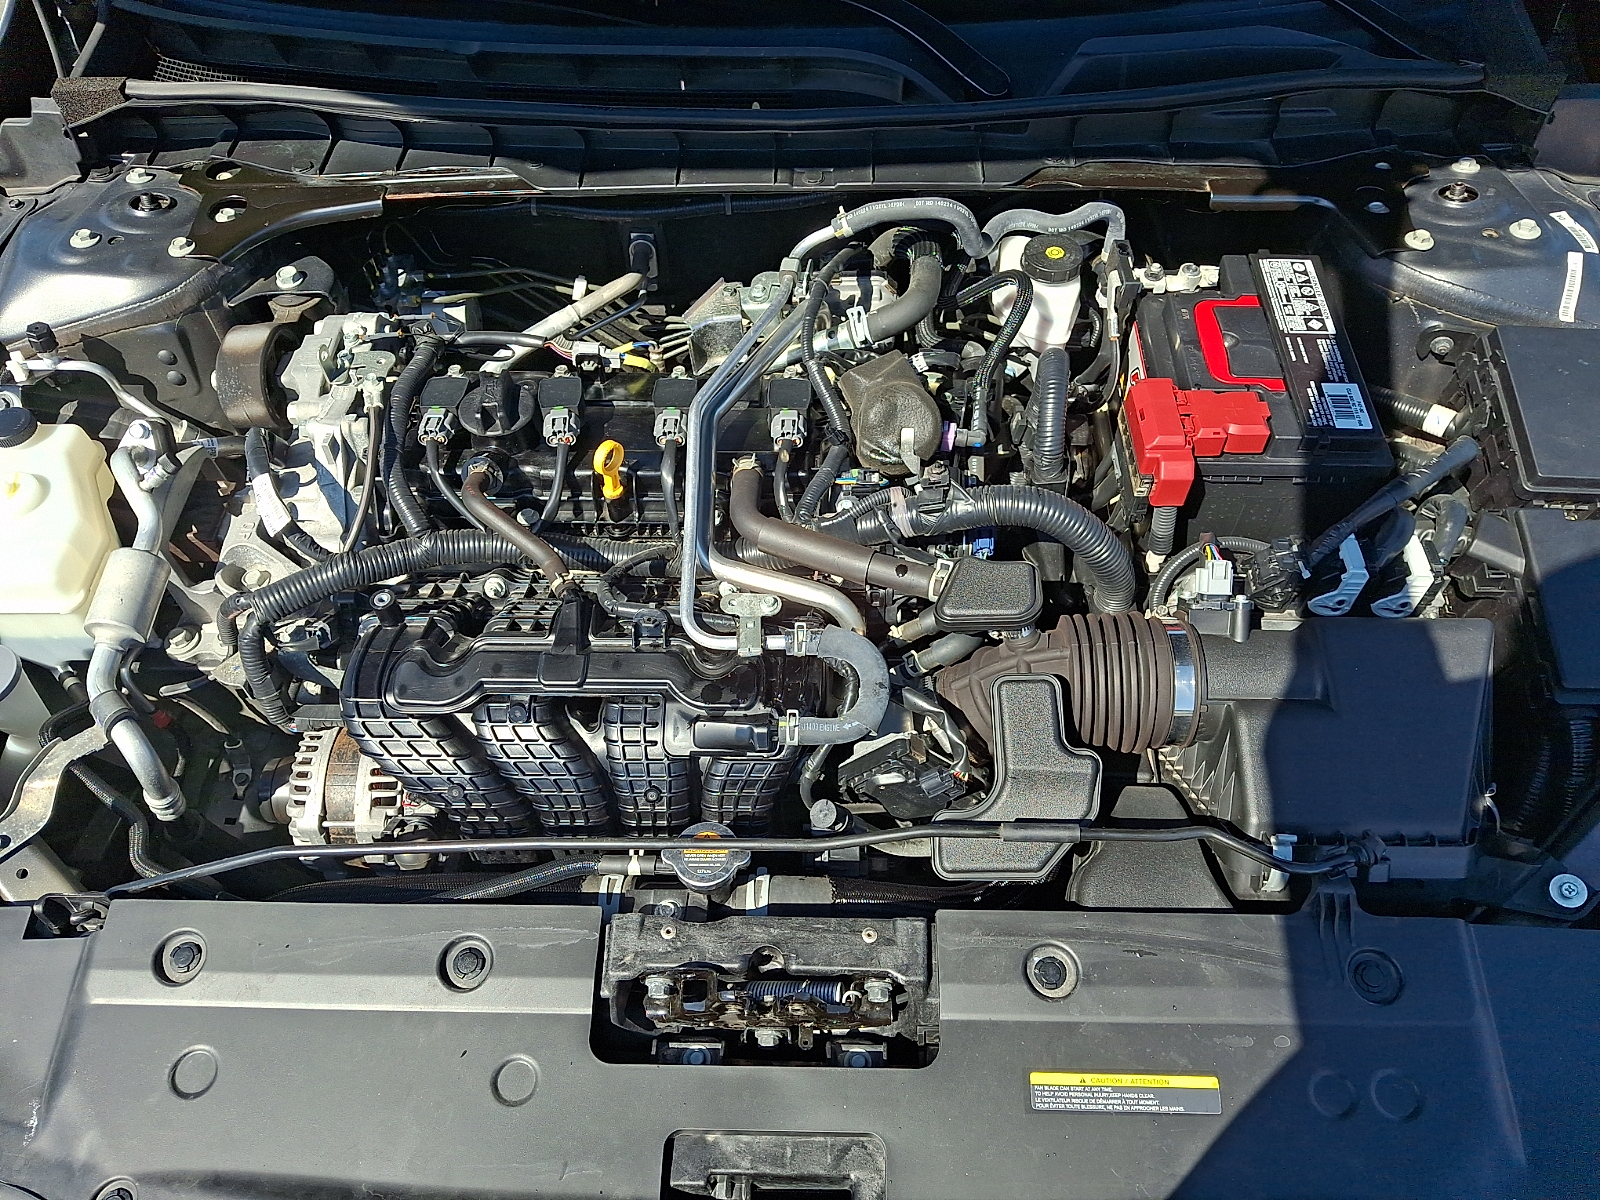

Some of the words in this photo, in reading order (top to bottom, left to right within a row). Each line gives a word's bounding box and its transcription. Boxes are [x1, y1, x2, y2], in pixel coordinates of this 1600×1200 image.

[1319, 299, 1330, 320] POISON
[820, 723, 840, 732] ENGINE
[1130, 1078, 1170, 1086] ATTENTION
